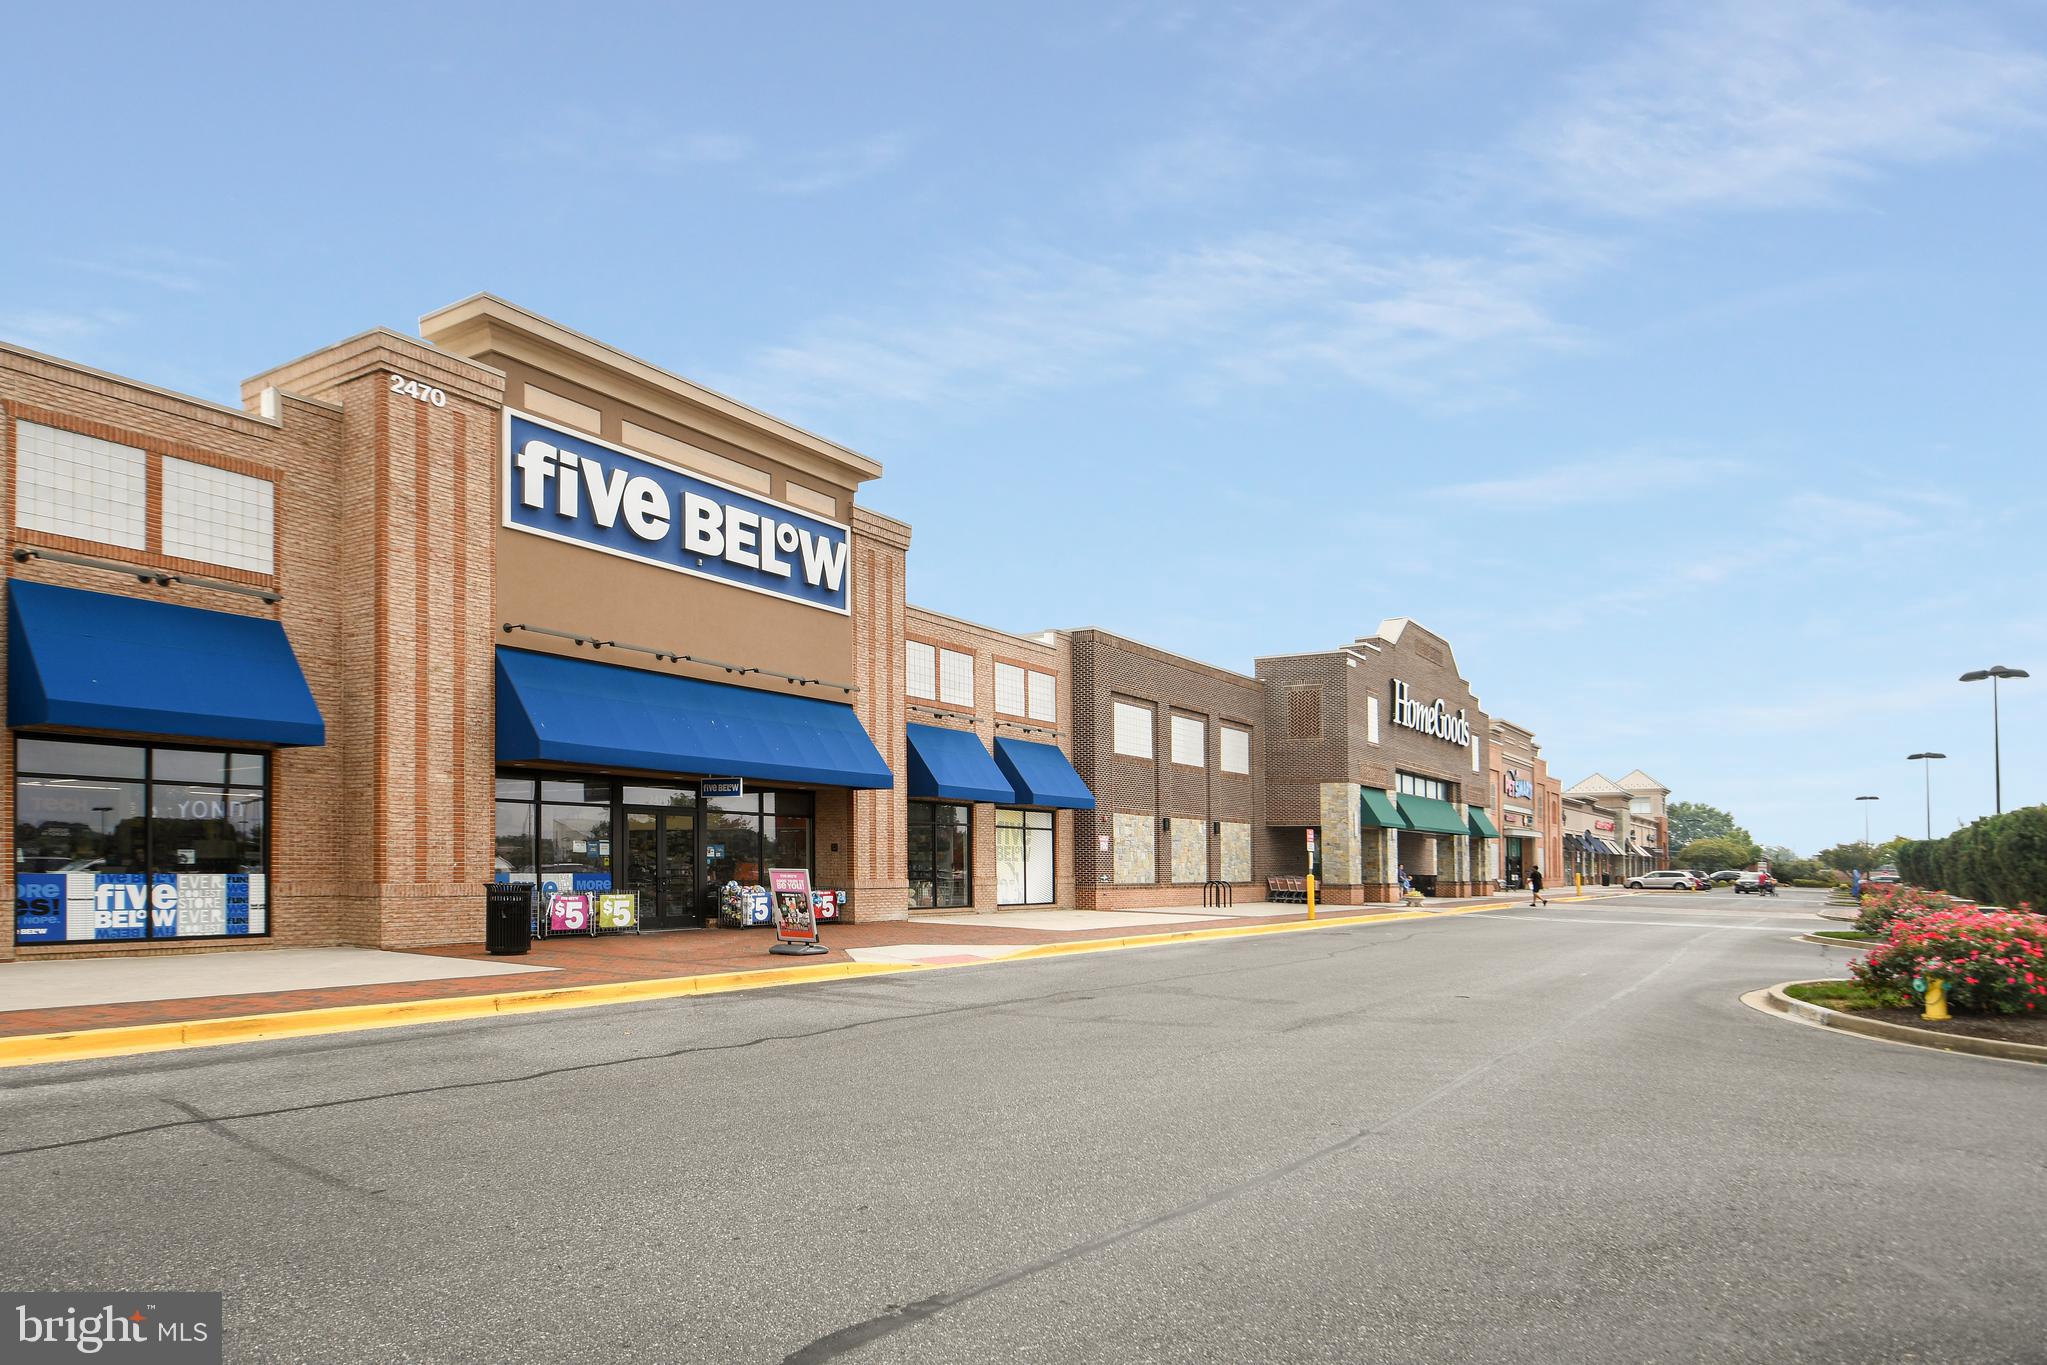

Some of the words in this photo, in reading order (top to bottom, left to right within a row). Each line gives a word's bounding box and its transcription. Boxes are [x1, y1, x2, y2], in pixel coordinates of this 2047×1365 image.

[390, 374, 446, 407] 2470
[514, 440, 671, 541] five
[1391, 678, 1470, 747] HomeGoods
[95, 883, 178, 910] five
[178, 898, 221, 908] STORE
[554, 900, 584, 929] $5
[603, 899, 631, 927] $5
